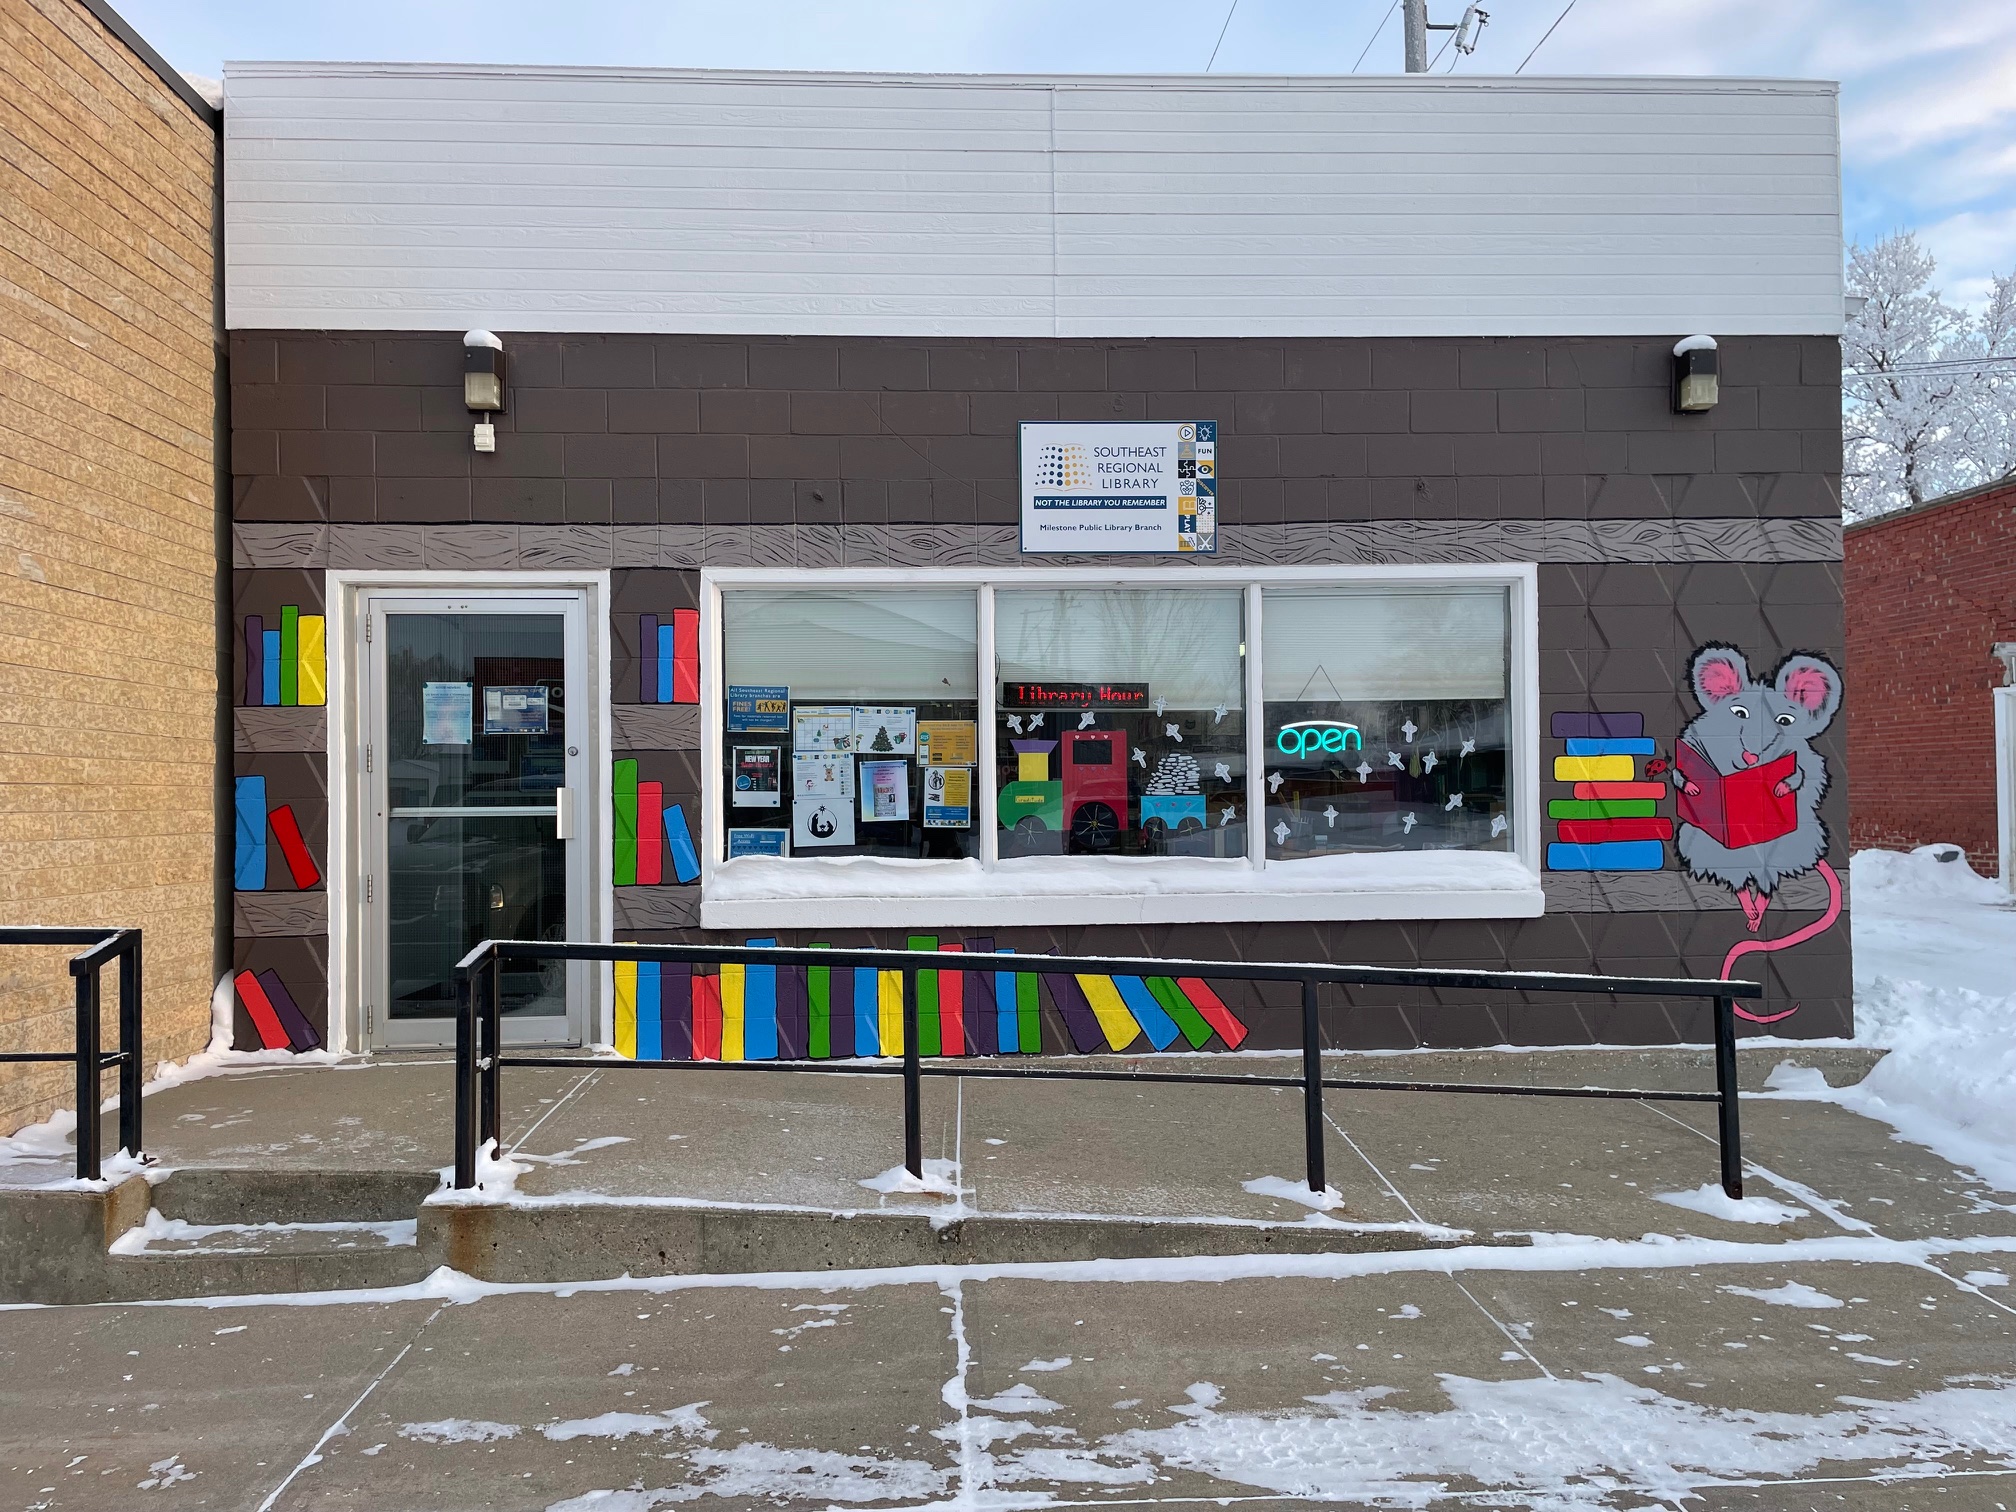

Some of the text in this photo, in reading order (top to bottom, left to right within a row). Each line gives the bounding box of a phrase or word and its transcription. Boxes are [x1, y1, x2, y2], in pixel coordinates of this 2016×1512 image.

[1093, 446, 1167, 458] SOUTHEAST
[1097, 462, 1164, 474] REGIONAL
[1102, 478, 1159, 489] LIBRARY
[1035, 499, 1166, 507] NOT THE LIBRARY YOU REMEMBER
[1104, 524, 1132, 532] Library
[1277, 728, 1362, 760] open
